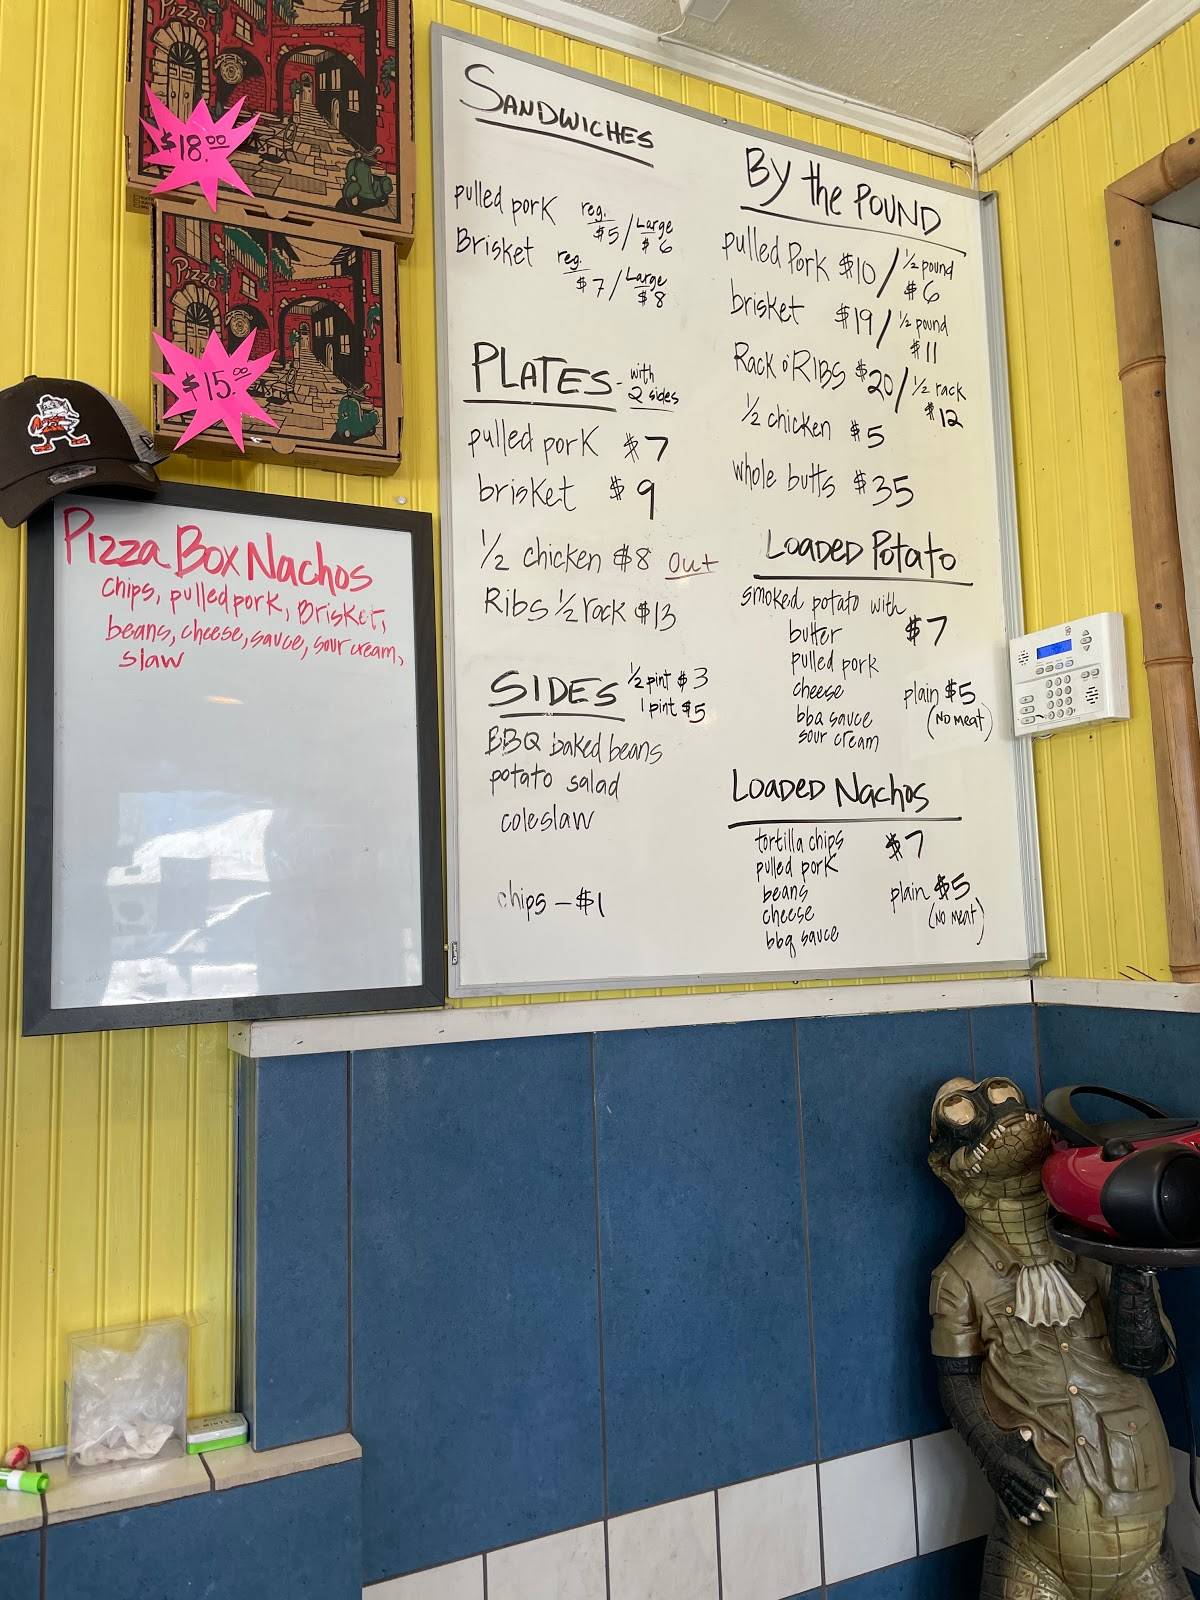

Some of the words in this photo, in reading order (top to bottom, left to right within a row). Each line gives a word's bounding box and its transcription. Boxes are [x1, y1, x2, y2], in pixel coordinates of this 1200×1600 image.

[454, 180, 503, 214] pulled
[745, 147, 791, 207] By
[801, 160, 842, 217] the
[854, 183, 941, 235] POUND
[581, 201, 606, 221] reg.
[636, 217, 673, 237] Large
[456, 226, 534, 267] Brisket
[557, 250, 582, 270] reg.
[722, 225, 781, 268] pulled
[839, 252, 876, 285] $10
[921, 260, 954, 280] pound
[171, 257, 217, 289] Pizza
[626, 267, 667, 292] Large
[730, 278, 804, 325] brisket
[834, 302, 873, 336] $19
[915, 315, 949, 337] pound
[630, 362, 655, 385] with
[734, 342, 776, 379] Rack
[855, 359, 894, 399] $20
[935, 381, 967, 401] rack
[628, 386, 643, 403] 2
[648, 386, 679, 405] sides
[768, 404, 831, 440] chicken
[924, 401, 963, 428] $12
[468, 418, 533, 458] pulled
[478, 473, 577, 512] brisket
[732, 452, 777, 490] whole
[788, 462, 836, 498] butts
[853, 469, 914, 508] $35
[63, 507, 171, 569] Pizza
[175, 525, 240, 579] Box
[247, 532, 373, 596] Nachos
[523, 536, 601, 573] chicken
[872, 530, 956, 578] Potato
[170, 582, 229, 614] pulled
[484, 586, 548, 622] Ribs
[583, 597, 627, 625] rack
[634, 600, 676, 632] $13
[741, 586, 805, 610] smoked
[812, 589, 860, 616] potato
[870, 592, 906, 616] with
[106, 614, 176, 647] beans,
[181, 619, 249, 649] cheese,
[251, 631, 309, 660] sauce,
[313, 637, 348, 657] sour
[350, 642, 405, 666] cream,
[789, 619, 843, 646] butter
[119, 648, 185, 671] slaw
[791, 649, 834, 675] pulled
[842, 653, 879, 680] pork
[487, 670, 619, 707] SIDES
[645, 669, 672, 694] pint
[792, 677, 845, 700] cheese
[904, 680, 939, 709] plain
[945, 678, 976, 705] $5
[649, 698, 678, 718] pint
[829, 711, 872, 728] sauce
[485, 725, 541, 756] BBQ
[549, 731, 601, 763] baked
[608, 733, 663, 765] beans
[798, 728, 827, 744] sour
[834, 730, 879, 752] cream
[489, 763, 553, 796] potato
[566, 769, 621, 800] salad
[835, 771, 930, 813] Nachos
[500, 804, 595, 833] coleslaw
[755, 828, 804, 854] tortilla
[809, 827, 844, 857] chips
[756, 856, 793, 882] pulled
[496, 880, 547, 921] chips
[763, 883, 809, 903] beans
[890, 880, 930, 914] plain
[762, 905, 815, 925] cheese
[766, 930, 797, 958] bbq
[801, 925, 840, 947] sauce
